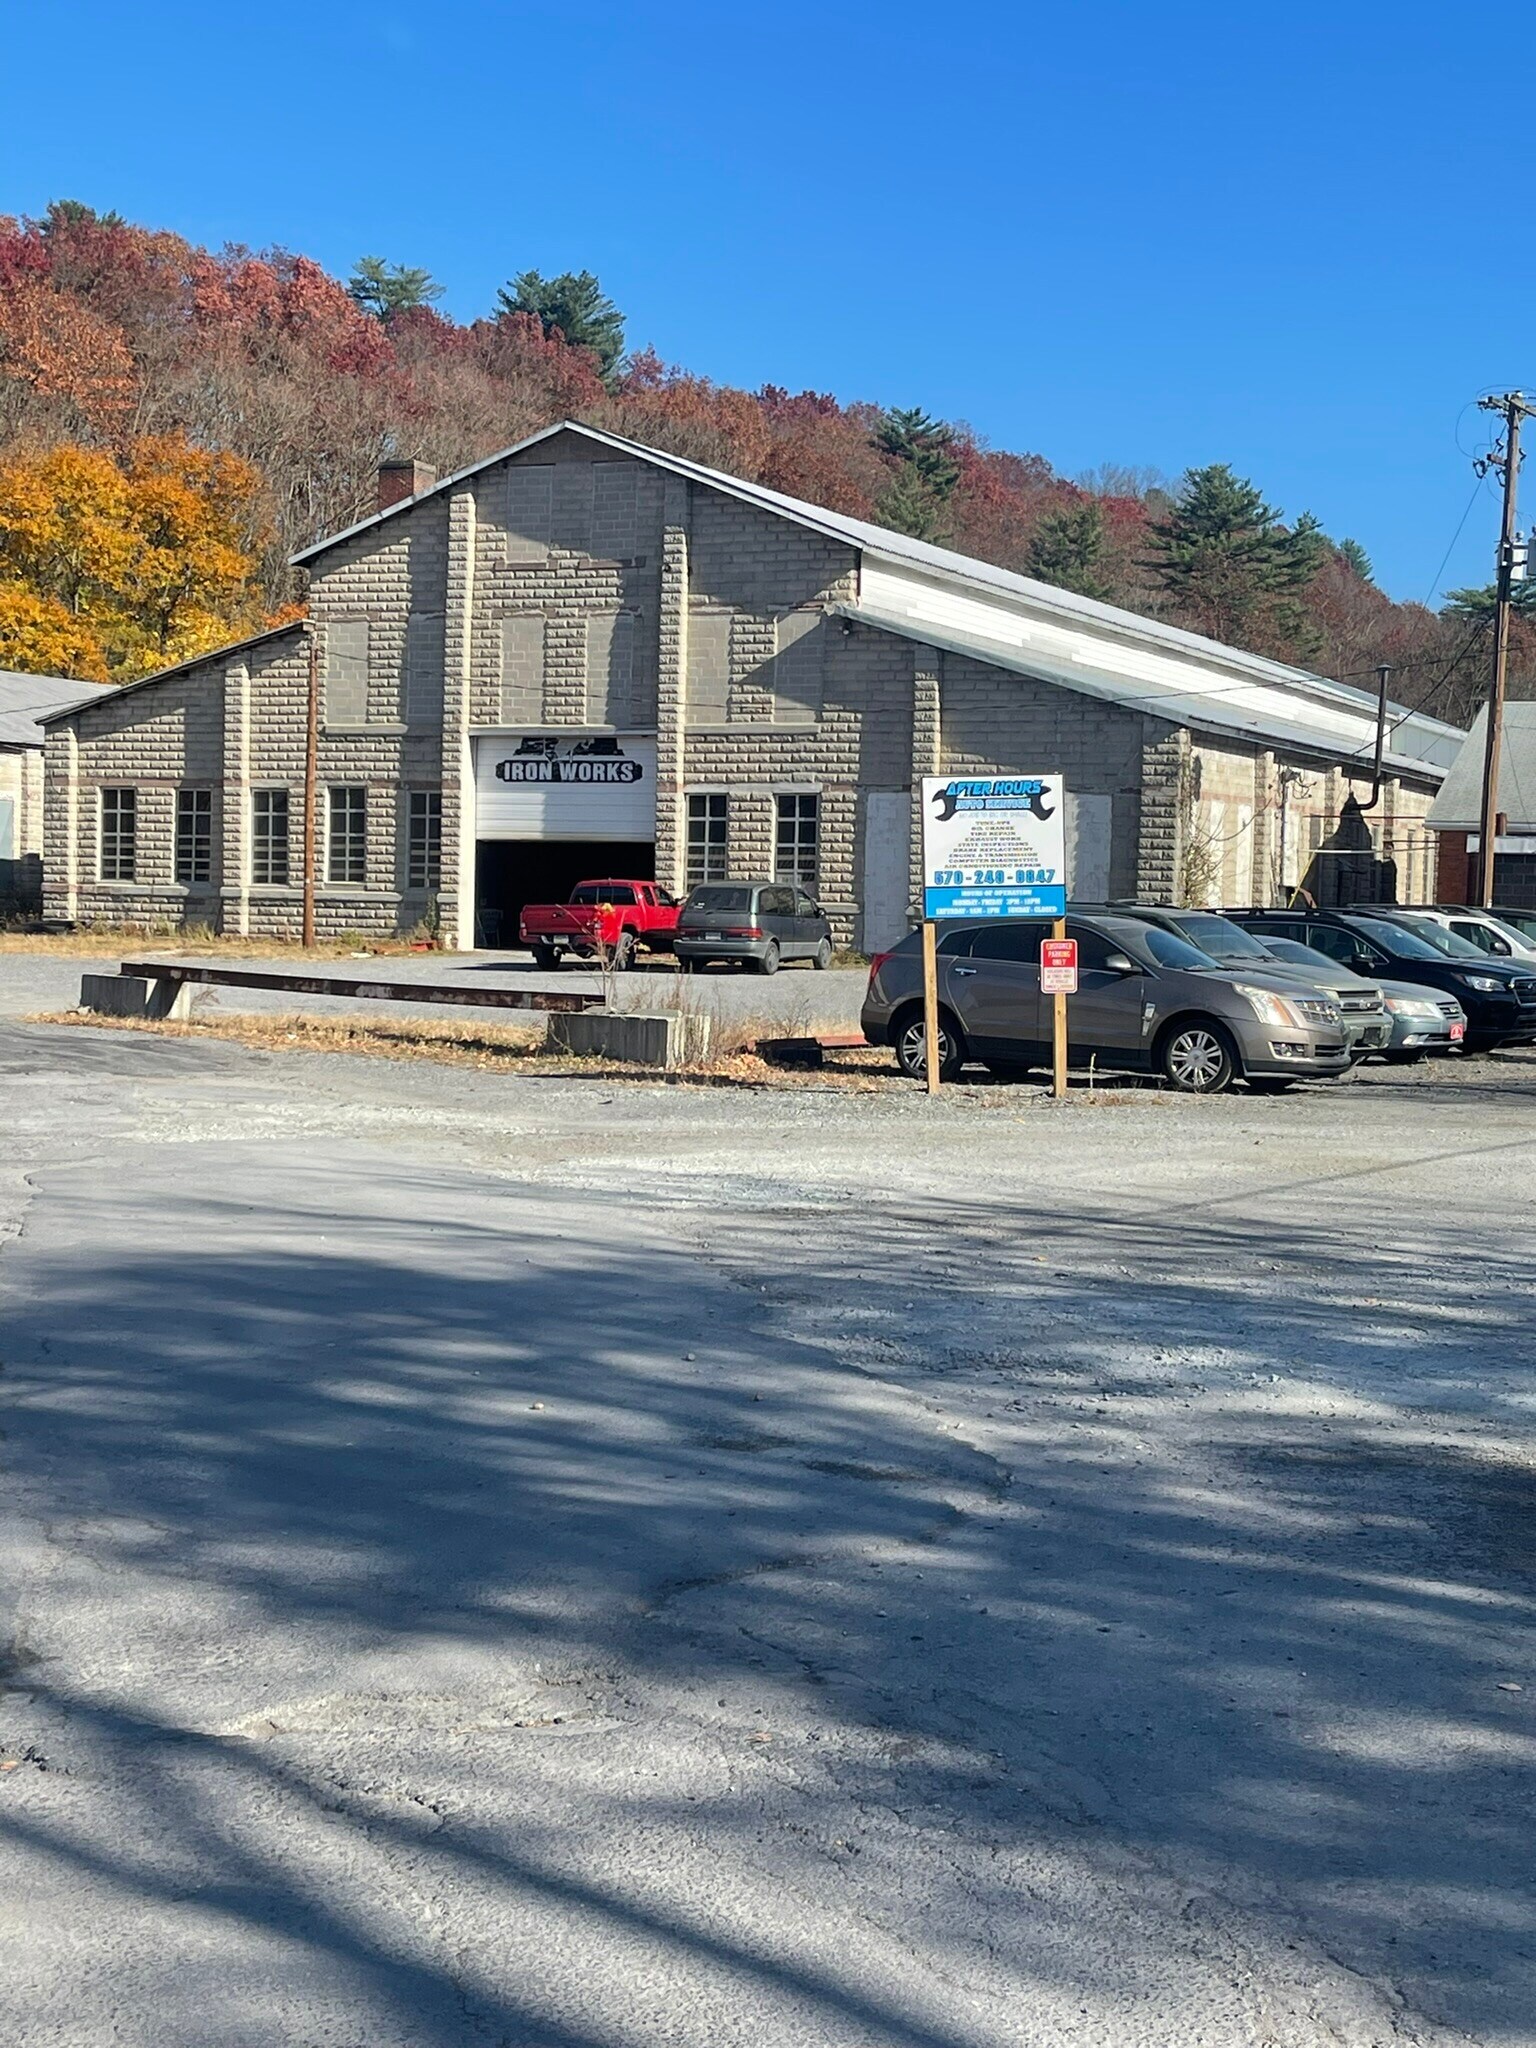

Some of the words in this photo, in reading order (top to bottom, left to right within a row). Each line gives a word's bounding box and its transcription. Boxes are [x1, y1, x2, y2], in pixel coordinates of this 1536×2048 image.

[504, 762, 552, 780] IRON
[559, 762, 634, 781] WORKS
[946, 781, 992, 797] AFTER
[994, 780, 1043, 796] HOURS
[955, 799, 984, 810] AUTO
